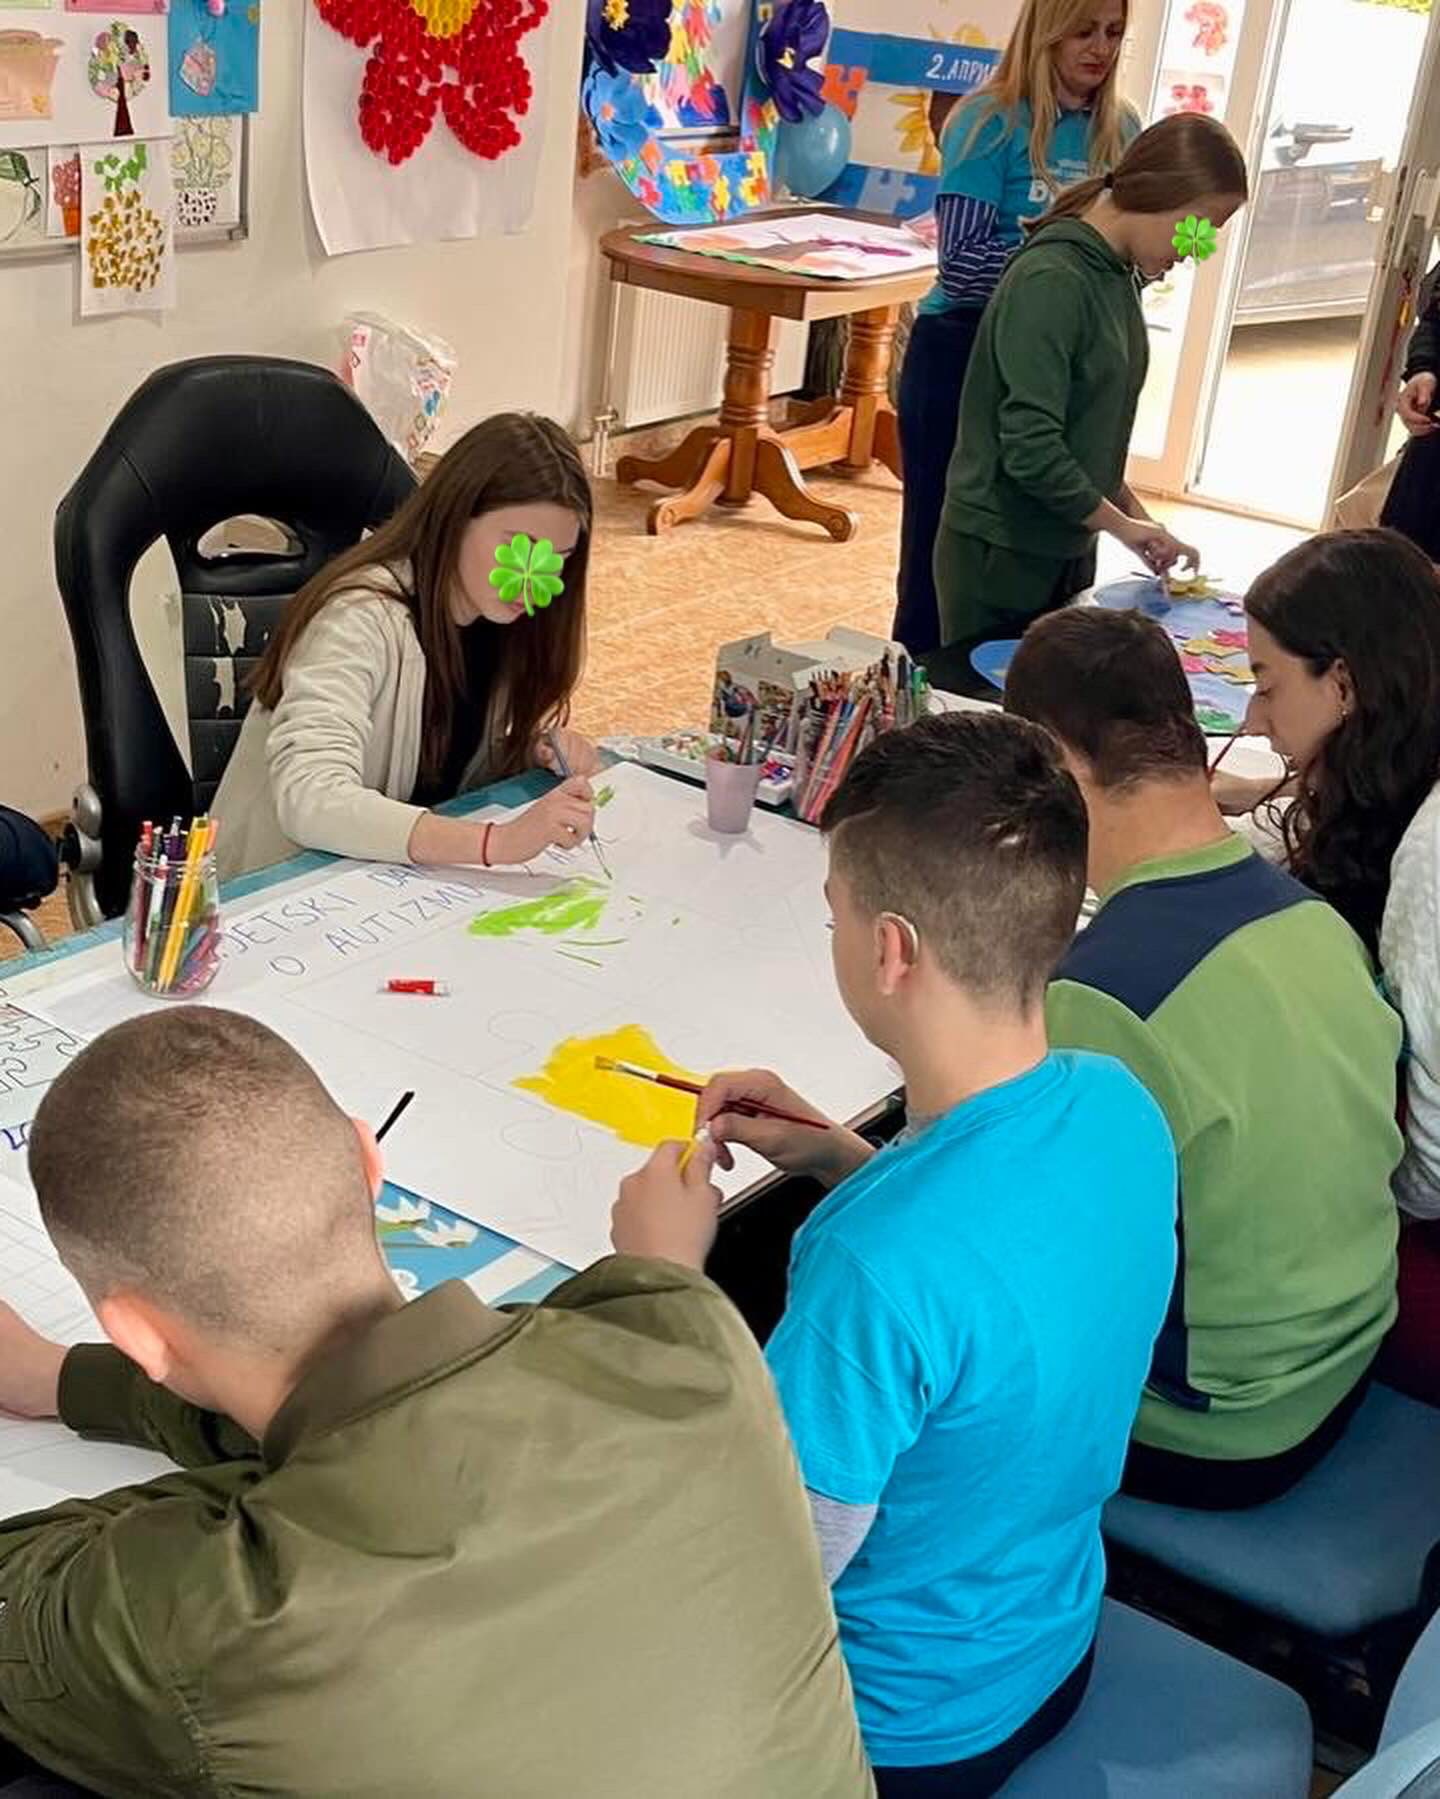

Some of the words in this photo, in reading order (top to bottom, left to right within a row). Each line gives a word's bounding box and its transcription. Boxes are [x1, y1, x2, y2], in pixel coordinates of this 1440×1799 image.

[222, 890, 357, 957] JETSKI
[268, 955, 306, 976] O
[325, 880, 484, 955] AUTIZMU
